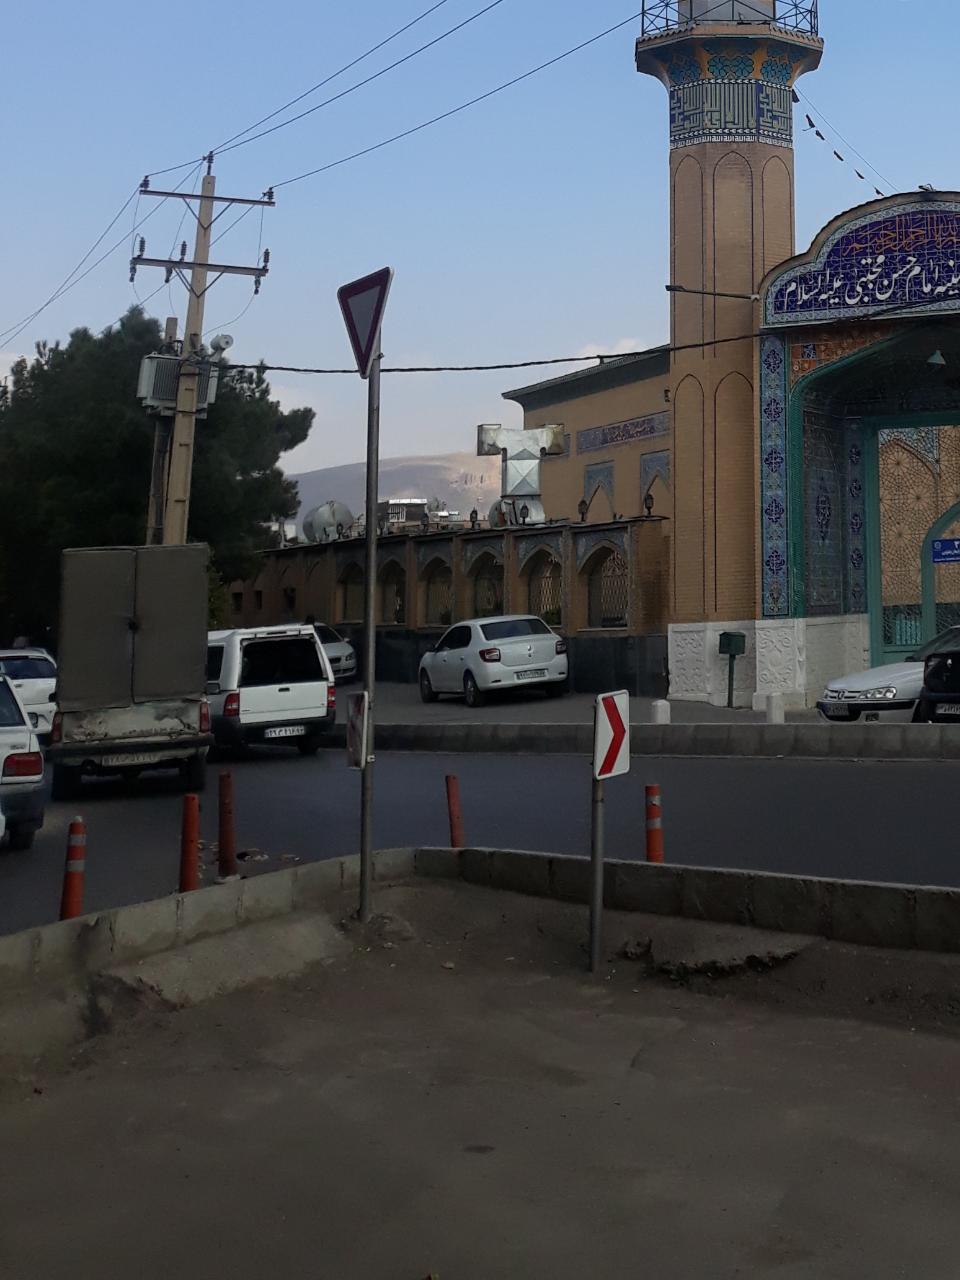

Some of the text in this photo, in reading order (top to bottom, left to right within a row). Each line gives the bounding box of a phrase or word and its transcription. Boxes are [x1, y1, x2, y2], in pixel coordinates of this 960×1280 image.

[784, 274, 822, 310] السلام
[818, 268, 844, 304] علیه
[845, 255, 885, 304] مجتبی
[875, 256, 918, 301] حسن
[905, 259, 939, 302] امام
